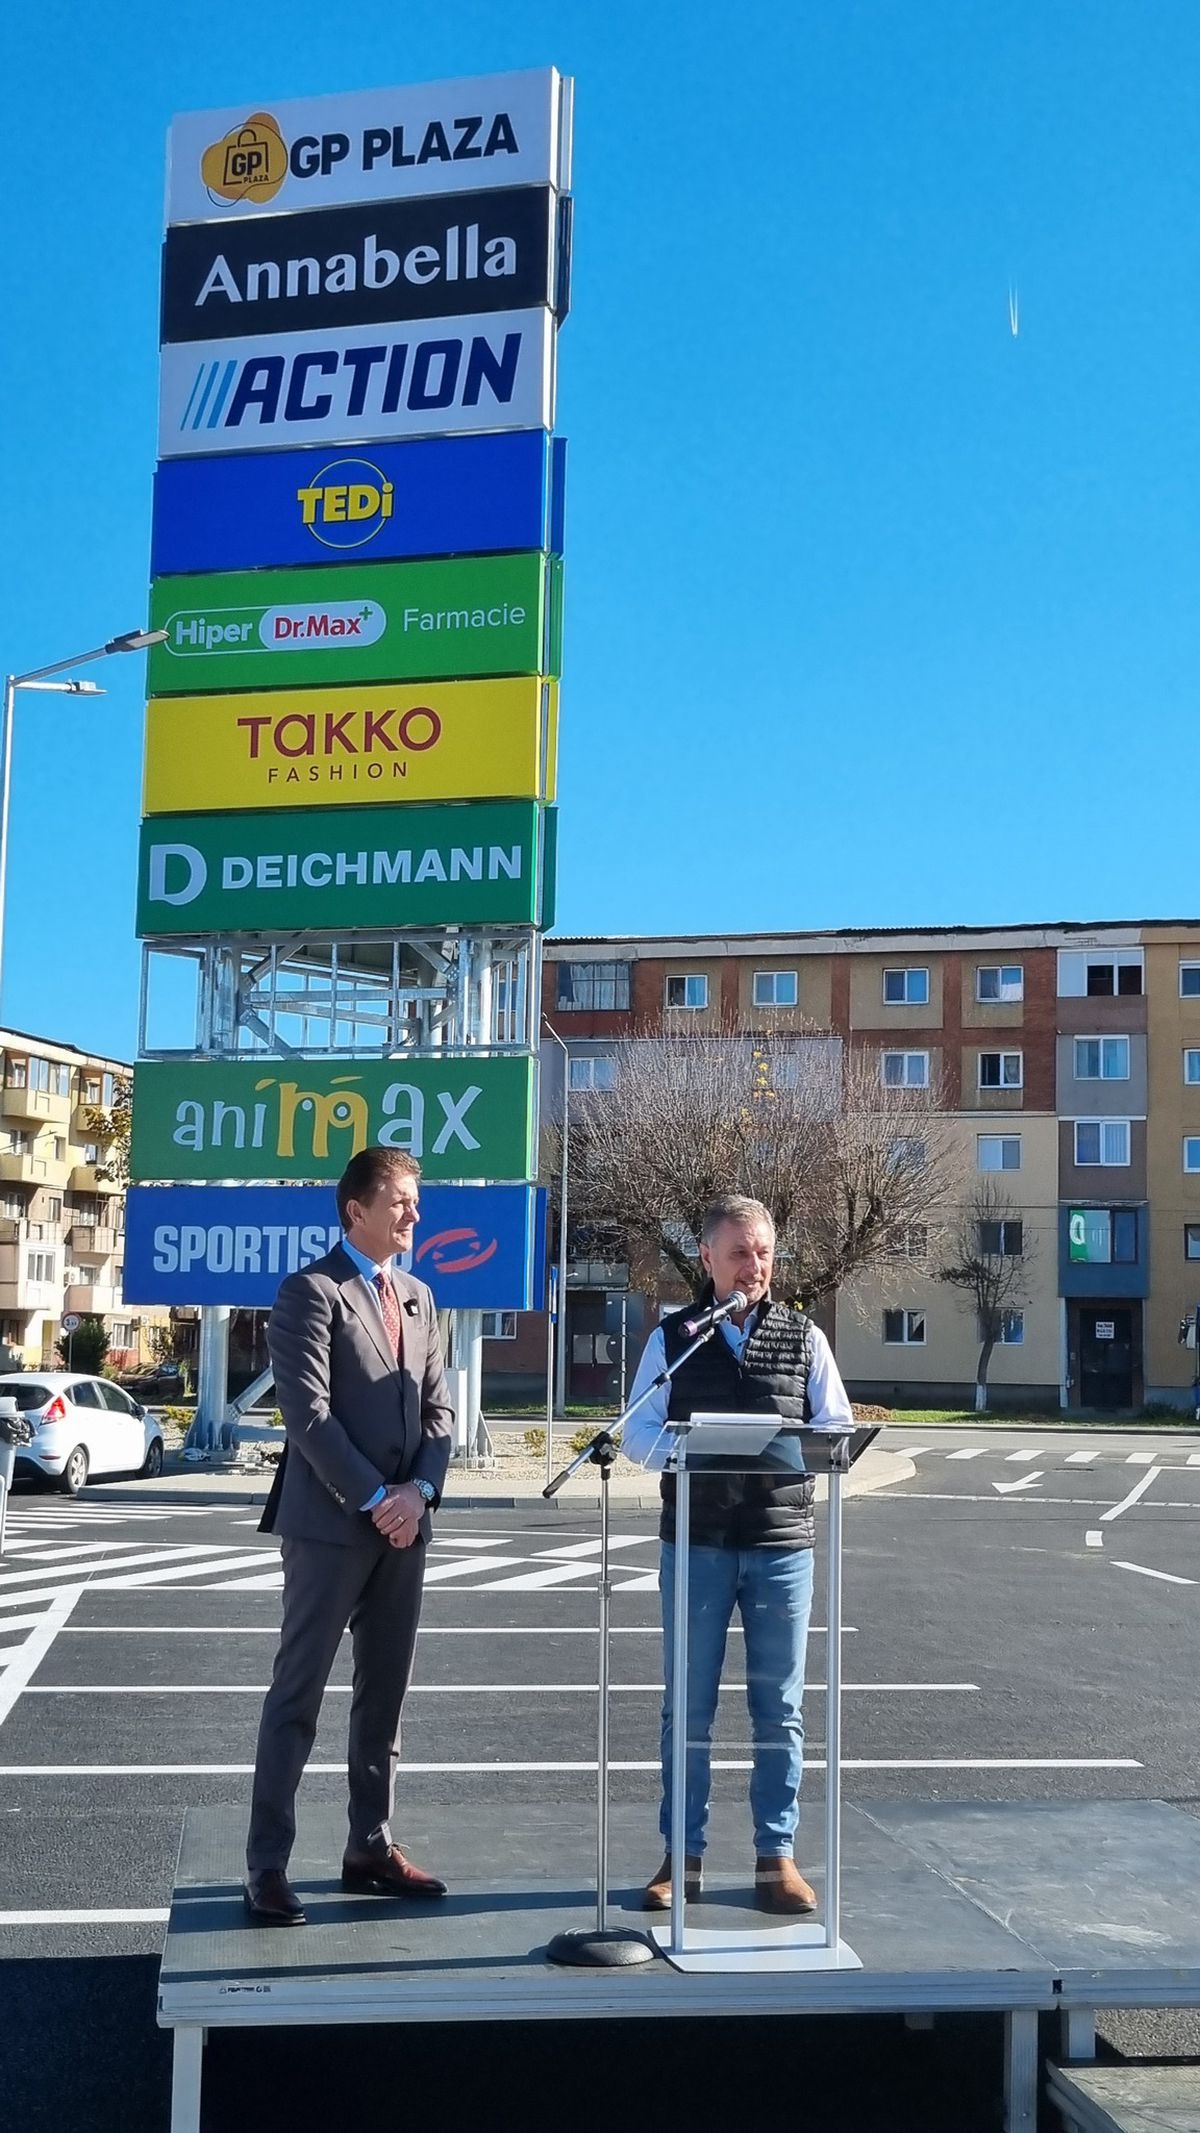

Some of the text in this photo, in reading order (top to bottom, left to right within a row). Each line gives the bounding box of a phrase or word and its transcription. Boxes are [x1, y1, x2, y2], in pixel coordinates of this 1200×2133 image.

[232, 151, 262, 176] GP
[290, 113, 519, 178] GP PLAZA
[243, 175, 269, 183] PLAZA
[195, 224, 517, 306] Annabella
[224, 333, 522, 427] ACTION
[297, 482, 394, 525] TEDi
[175, 620, 253, 649] Hiper
[403, 603, 526, 632] Farmacie
[268, 761, 407, 784] FASHION
[149, 844, 522, 905] D DEICHMANN
[173, 1076, 483, 1158] animax
